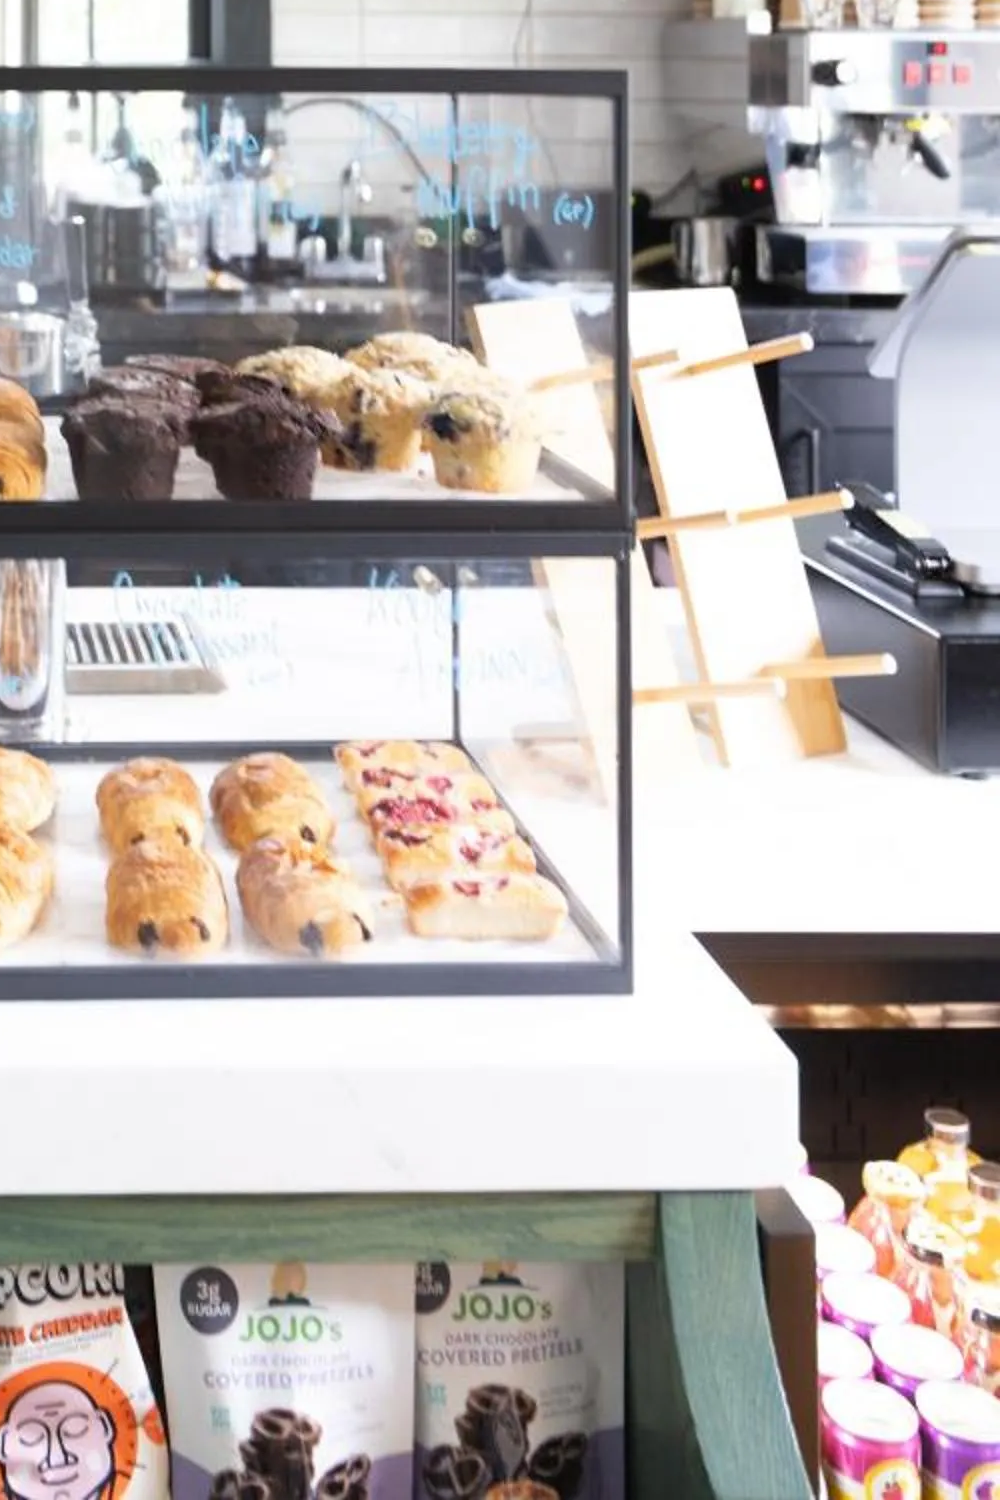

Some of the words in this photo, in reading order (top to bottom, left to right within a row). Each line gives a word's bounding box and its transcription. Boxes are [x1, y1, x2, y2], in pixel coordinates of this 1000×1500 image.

[452, 1293, 553, 1321] JOJO's
[29, 1305, 125, 1342] CHEDDAR
[238, 1313, 344, 1344] JOJO's
[417, 1348, 506, 1367] COVERED
[510, 1337, 585, 1366] PRETZELS
[203, 1369, 294, 1391] COVERED
[297, 1362, 376, 1387] PRETZELS
